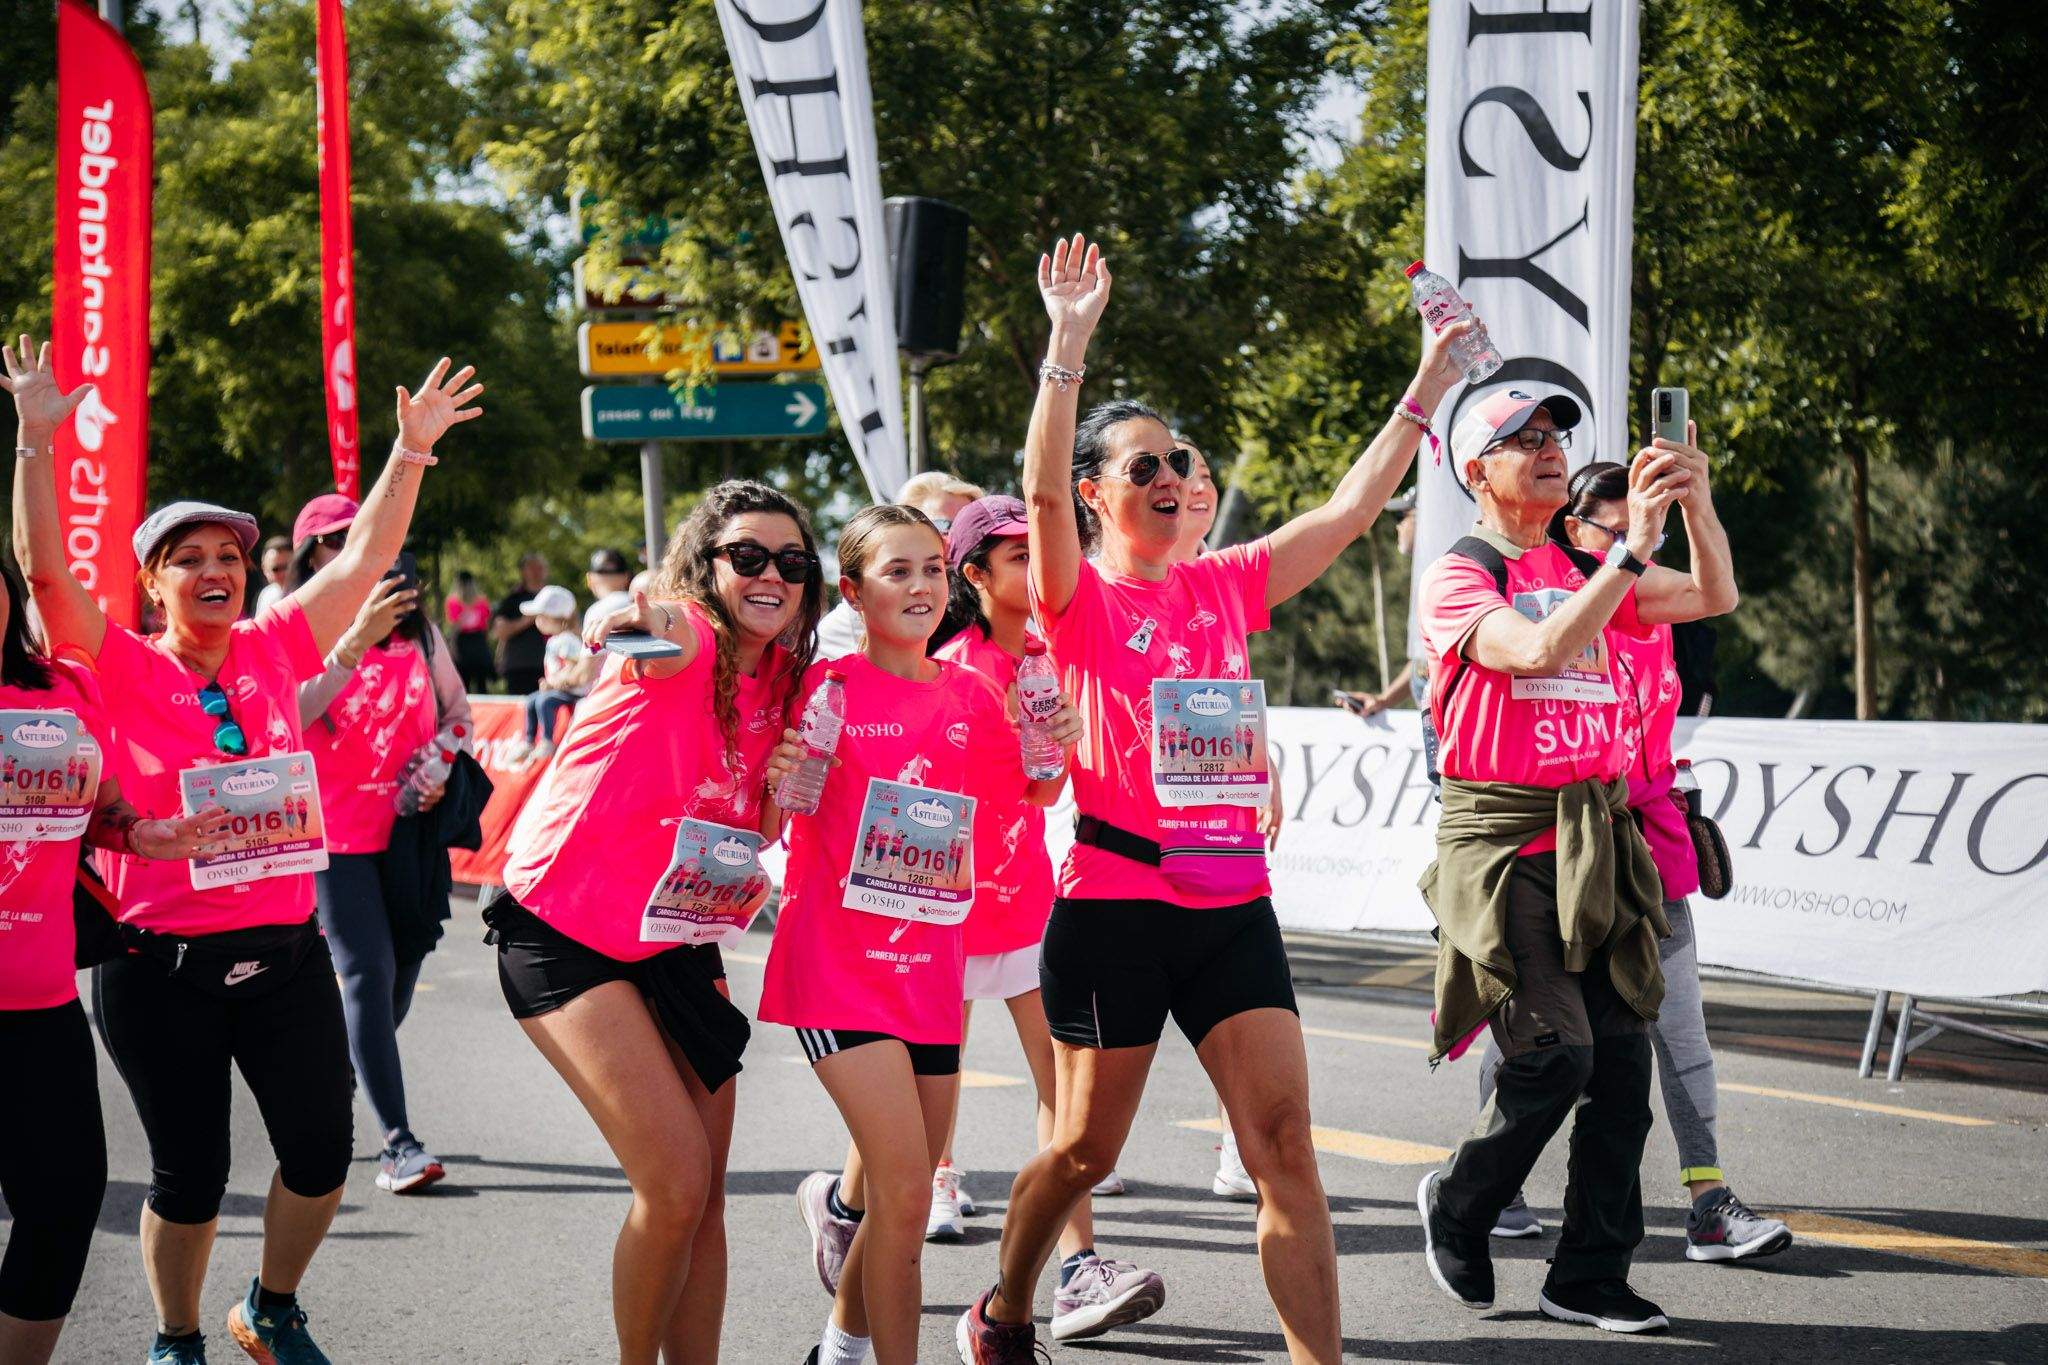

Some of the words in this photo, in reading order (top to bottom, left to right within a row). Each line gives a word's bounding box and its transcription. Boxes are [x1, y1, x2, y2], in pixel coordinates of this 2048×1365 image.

[1425, 305, 1441, 321] ERO
[1525, 682, 1564, 694] OYSHO
[171, 692, 201, 706] OYS
[1189, 698, 1231, 710] ASTURIANA
[16, 729, 65, 742] ASTURIANA
[846, 723, 904, 738] OYSHO
[1190, 736, 1233, 757] 016
[1198, 762, 1225, 772] 12812
[17, 767, 63, 790] 016
[226, 778, 276, 792] ASTURIANA
[1233, 774, 1257, 782] MADRID
[1269, 740, 1439, 829] YSH
[24, 795, 46, 805] 5108
[1168, 789, 1204, 800] OYSHO
[1225, 791, 1260, 799] Santander
[16, 807, 25, 815] DE
[24, 807, 32, 815] LA
[32, 807, 53, 816] MUJER
[911, 804, 952, 823] ASTURIANA
[0, 822, 23, 833] SHO
[45, 823, 85, 833] Santander
[231, 810, 282, 836] 016
[1157, 818, 1189, 829] CARRERA
[245, 837, 269, 849] 5105
[237, 851, 247, 860] DE
[247, 850, 256, 859] LA
[256, 846, 278, 857] MUJER
[283, 841, 310, 852] MADRID
[716, 847, 750, 861] ASTURIANA
[902, 845, 946, 872] 016
[206, 865, 249, 881] OYSHO
[273, 857, 314, 870] Santander
[907, 873, 934, 886] 12813
[693, 880, 737, 902] 016
[865, 877, 897, 891] CARRERA
[898, 883, 908, 893] DE
[908, 884, 917, 894] LA
[918, 887, 937, 897] MUJER
[861, 892, 906, 910] OYSHO
[1732, 883, 1908, 924] WW.OYSHO.COM
[656, 908, 681, 917] CARRERA
[680, 911, 688, 919] DE
[688, 912, 697, 920] LA
[650, 923, 681, 934] OYSHO
[865, 949, 898, 962] CARRERA
[230, 960, 261, 977] NIKE
[894, 963, 911, 974] 2024
